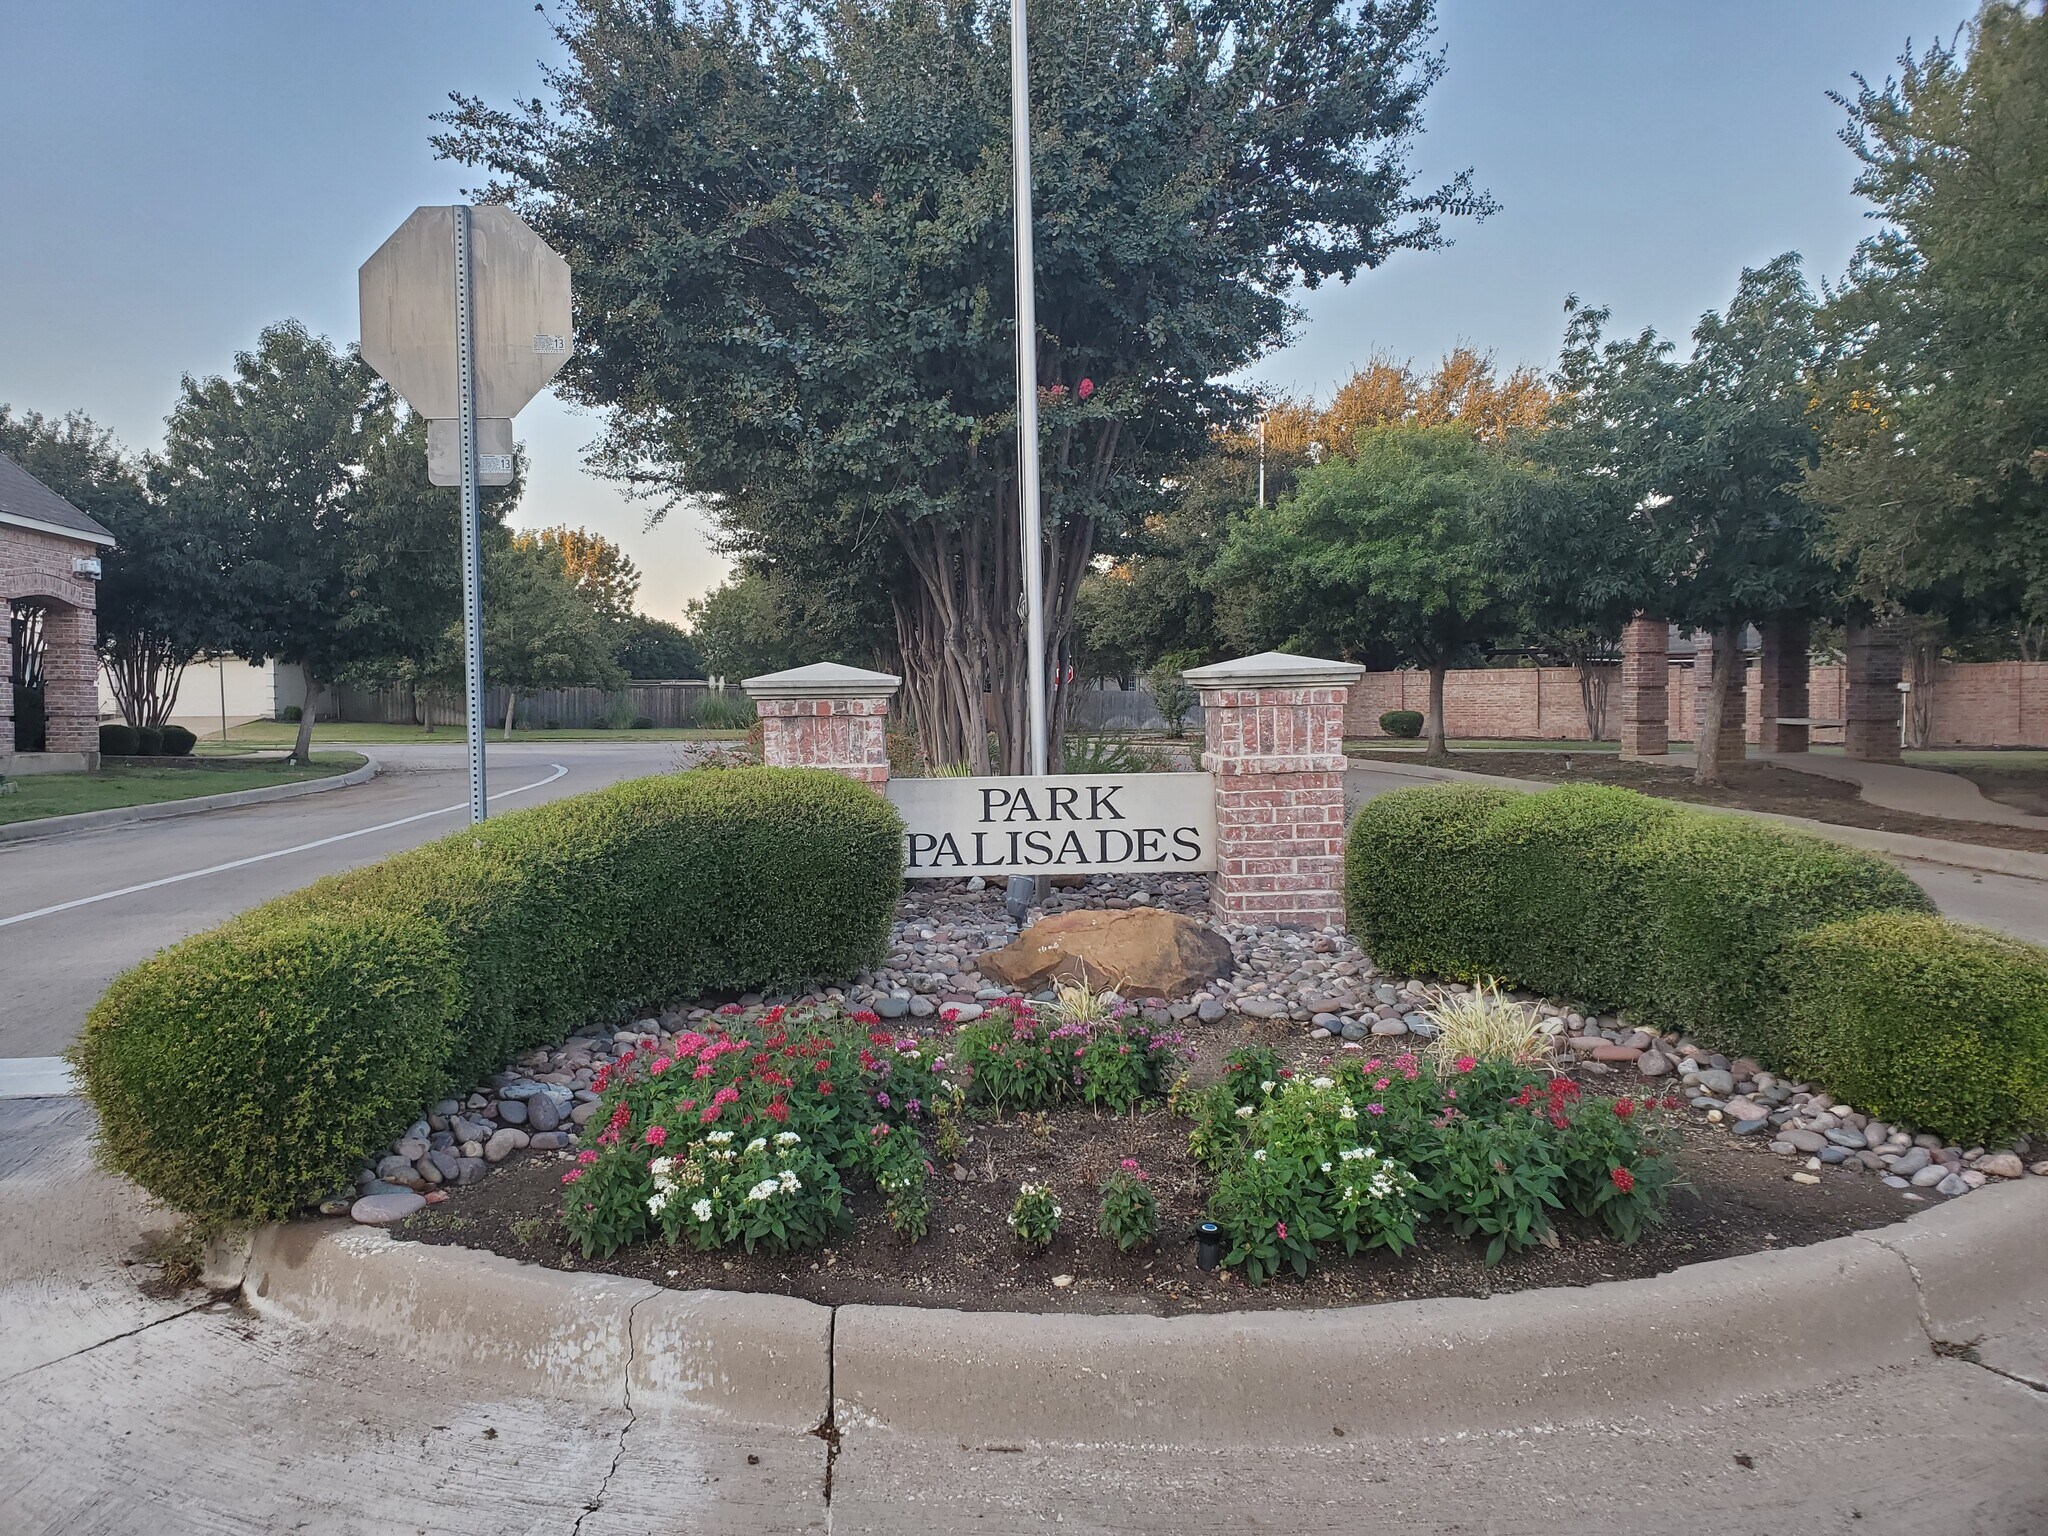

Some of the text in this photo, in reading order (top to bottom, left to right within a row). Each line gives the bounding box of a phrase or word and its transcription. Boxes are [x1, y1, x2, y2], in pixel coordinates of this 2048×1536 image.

[554, 339, 564, 348] 13
[501, 459, 510, 469] 13
[978, 785, 1126, 823] PARK
[907, 827, 1201, 868] PALISADES
